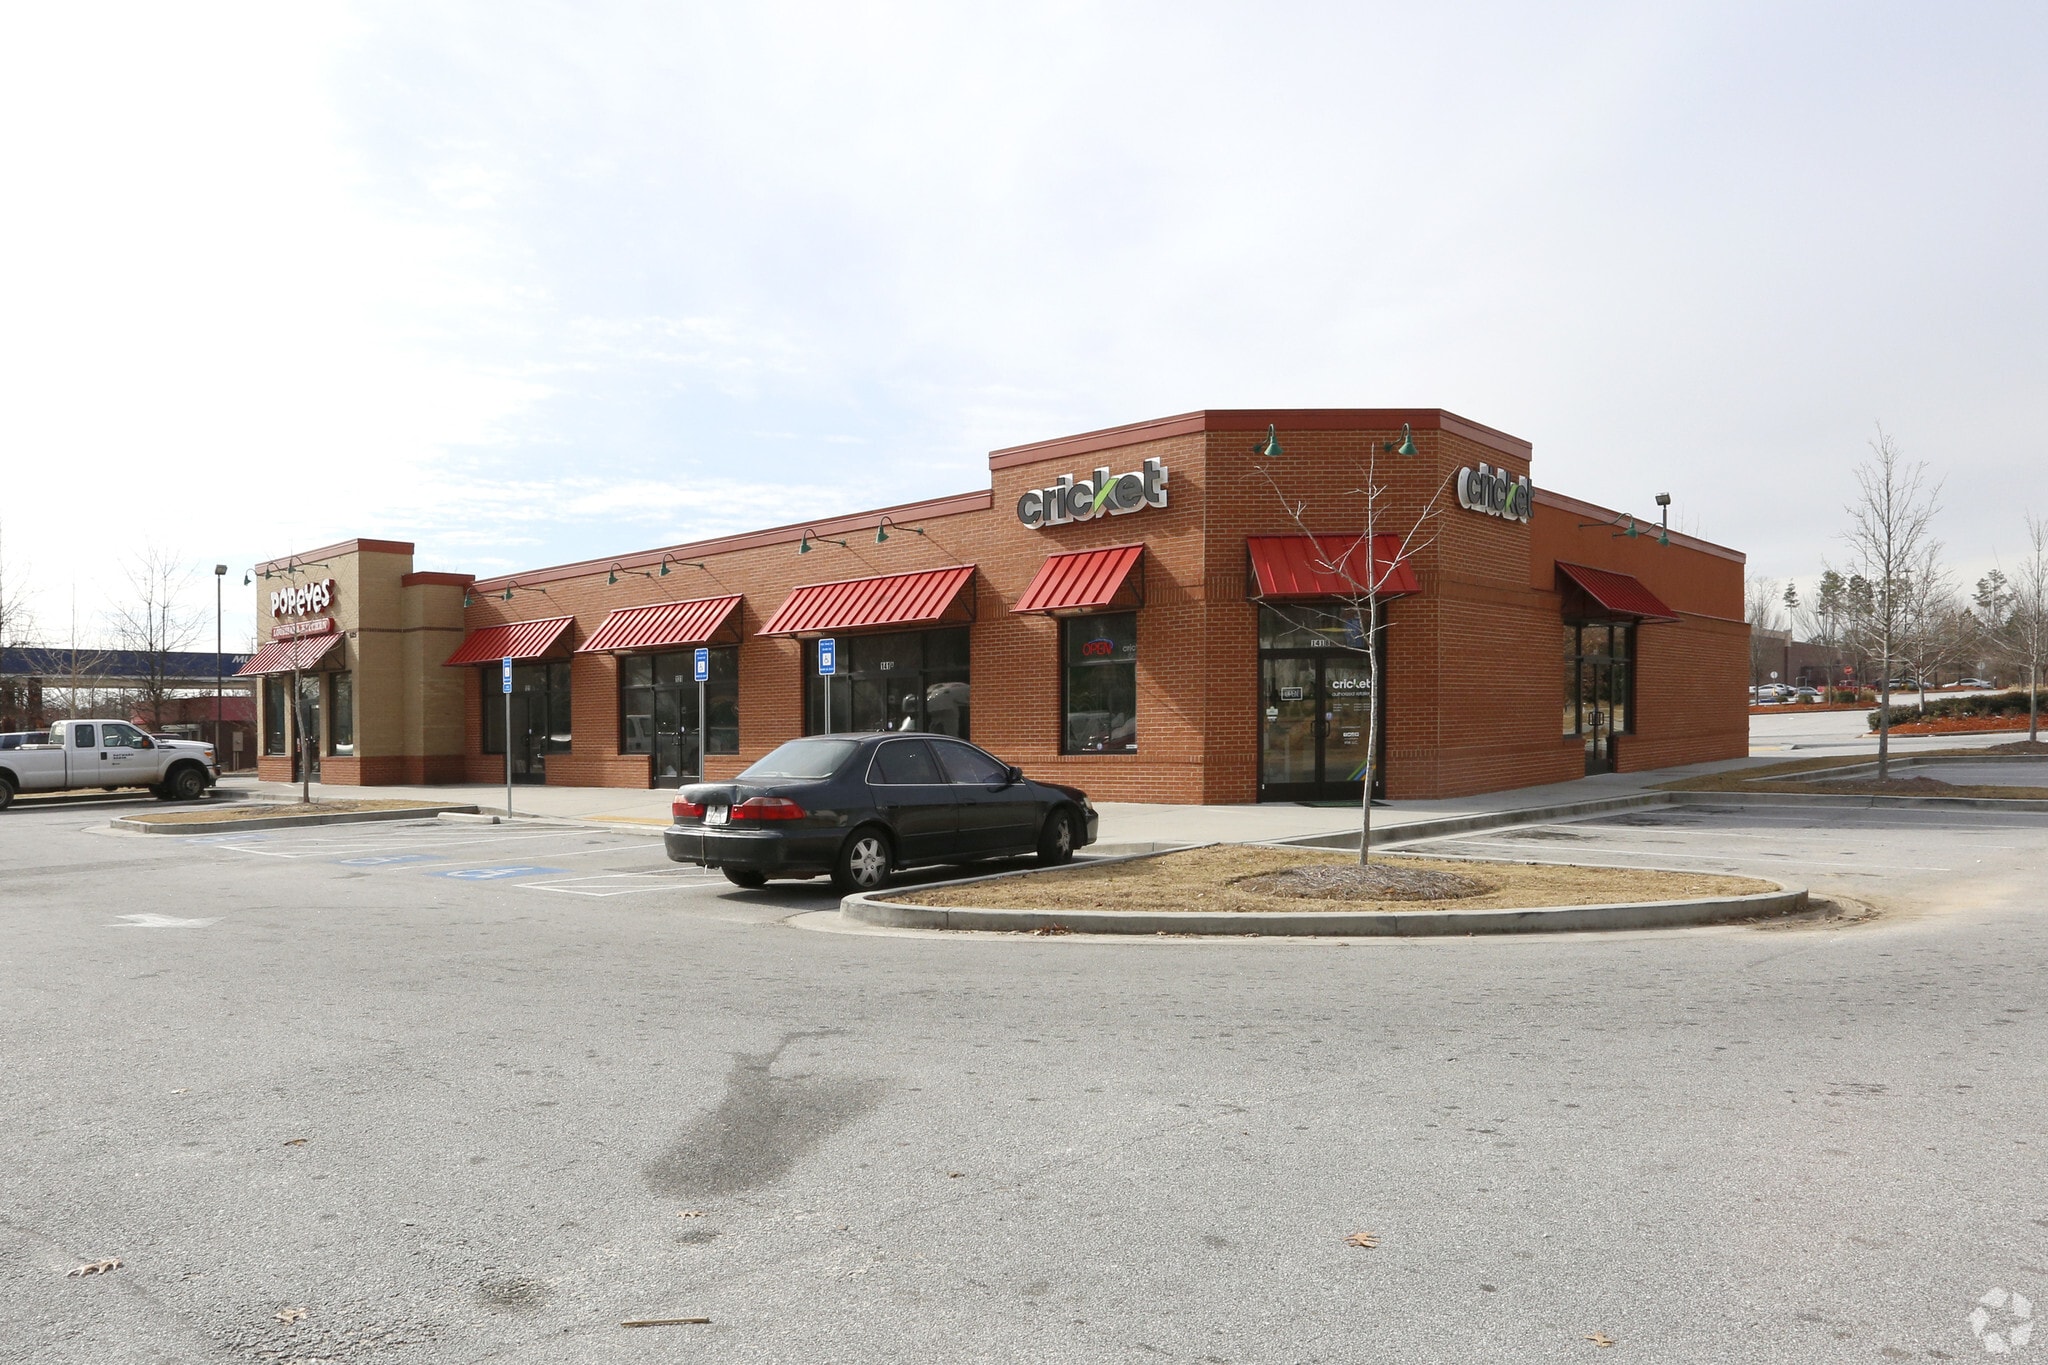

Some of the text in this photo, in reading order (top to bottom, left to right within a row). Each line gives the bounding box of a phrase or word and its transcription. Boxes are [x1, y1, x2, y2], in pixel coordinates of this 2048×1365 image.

[1017, 457, 1168, 530] cricket
[1458, 462, 1535, 523] cricket
[1082, 642, 1112, 656] OPEN
[1332, 678, 1370, 689] cricket
